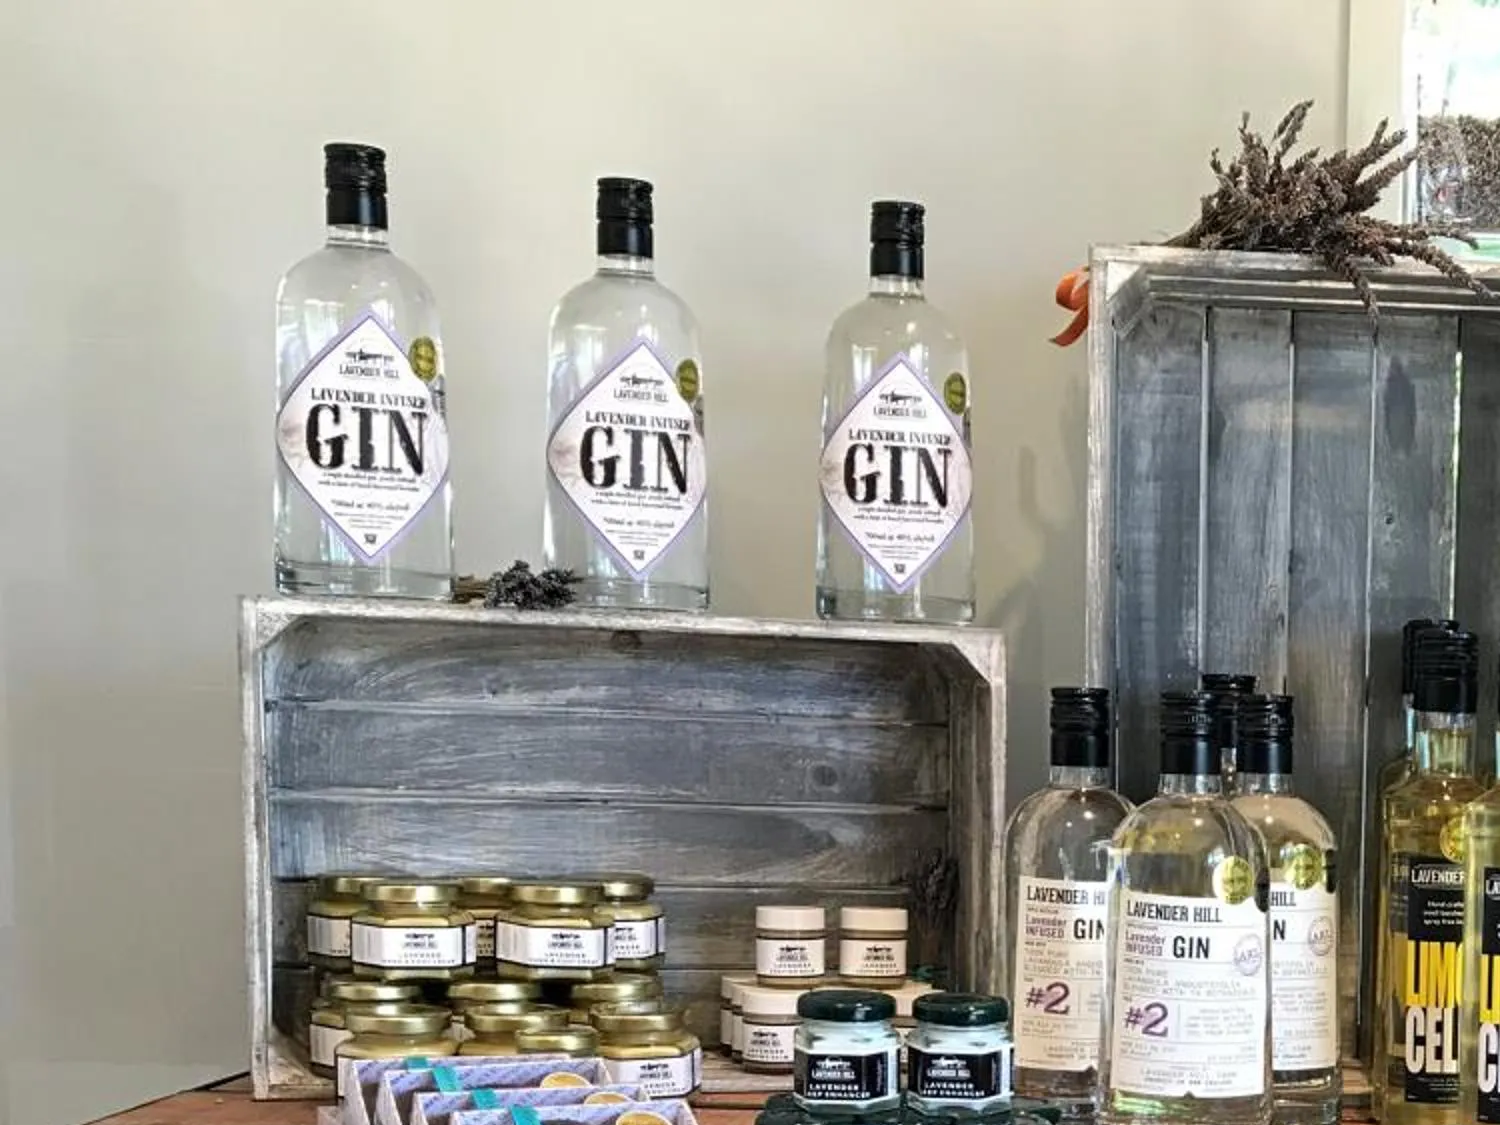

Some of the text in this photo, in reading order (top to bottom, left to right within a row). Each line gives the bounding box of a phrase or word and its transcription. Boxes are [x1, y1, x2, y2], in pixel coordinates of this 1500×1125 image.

[311, 387, 377, 405] LAVENDER
[585, 410, 647, 425] LAVENDER
[306, 403, 429, 477] GIN
[849, 428, 905, 443] LAVENDER
[580, 425, 692, 495] GIN
[844, 442, 953, 508] GIN
[1026, 885, 1089, 905] LAVENDER
[1126, 899, 1223, 923] LAVENDER HILL
[1025, 926, 1065, 940] INFUSED
[1125, 930, 1166, 945] Lavender
[1125, 942, 1163, 957] INFUSED
[1172, 934, 1211, 959] GIN
[1025, 980, 1071, 1016] #2
[1124, 1001, 1169, 1038] #2
